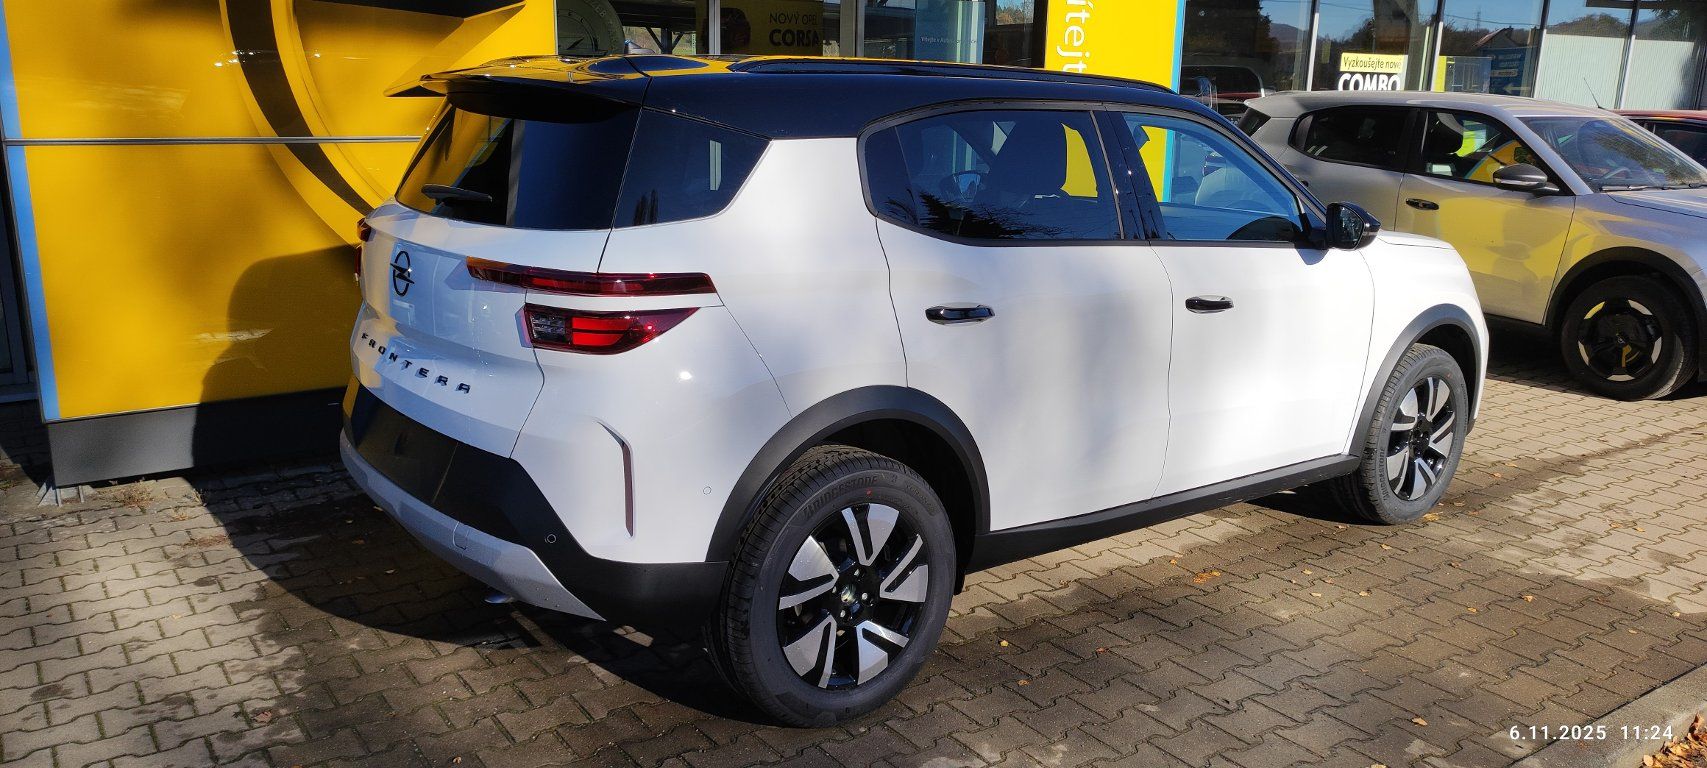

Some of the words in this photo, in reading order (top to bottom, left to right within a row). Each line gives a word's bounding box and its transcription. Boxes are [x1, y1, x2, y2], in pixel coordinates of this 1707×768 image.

[769, 8, 799, 24] NOVÝ
[769, 28, 821, 47] CORSA
[1344, 56, 1384, 70] Vyzkoušejte
[1338, 73, 1401, 91] COMBO
[361, 332, 471, 394] FRONTERA
[803, 476, 878, 519] BRIDGESTONE
